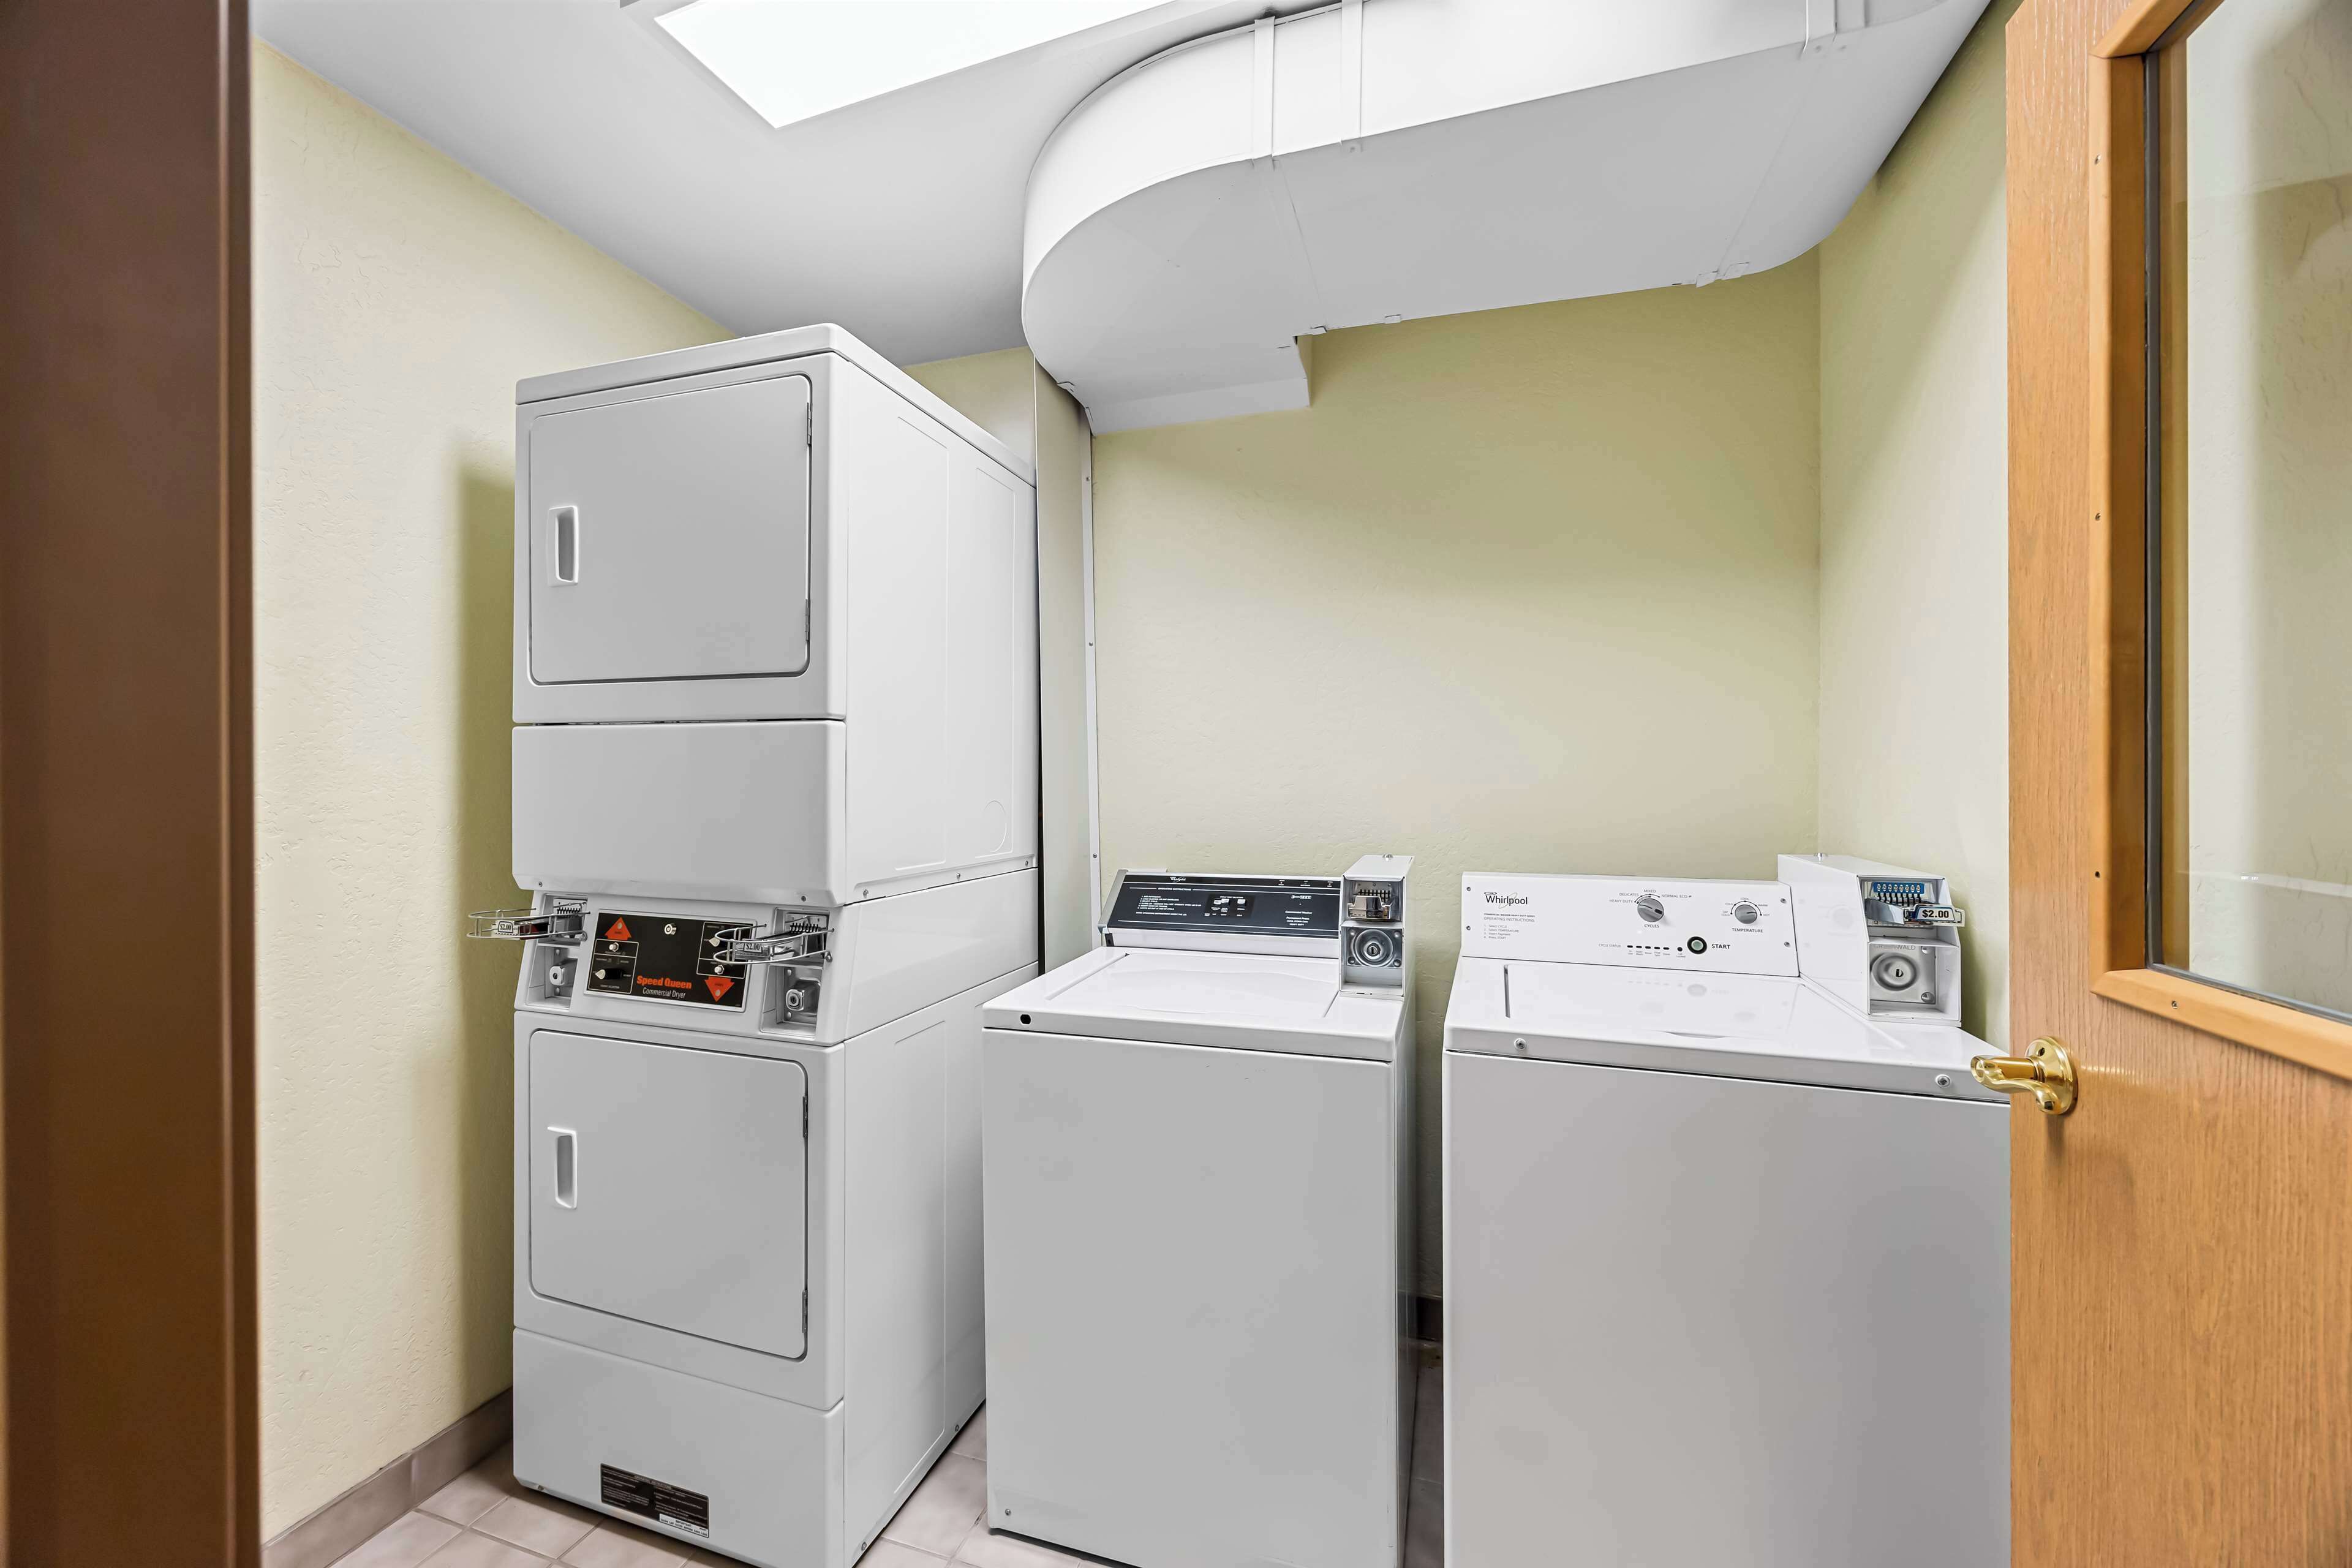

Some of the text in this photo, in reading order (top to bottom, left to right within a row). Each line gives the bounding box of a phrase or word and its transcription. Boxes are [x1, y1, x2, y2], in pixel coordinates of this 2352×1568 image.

[1485, 895, 1528, 907] Whirlpool
[1922, 909, 1949, 918] $2.00
[636, 975, 692, 989] Speed Queen
[643, 987, 686, 999] Commercial Dryer
